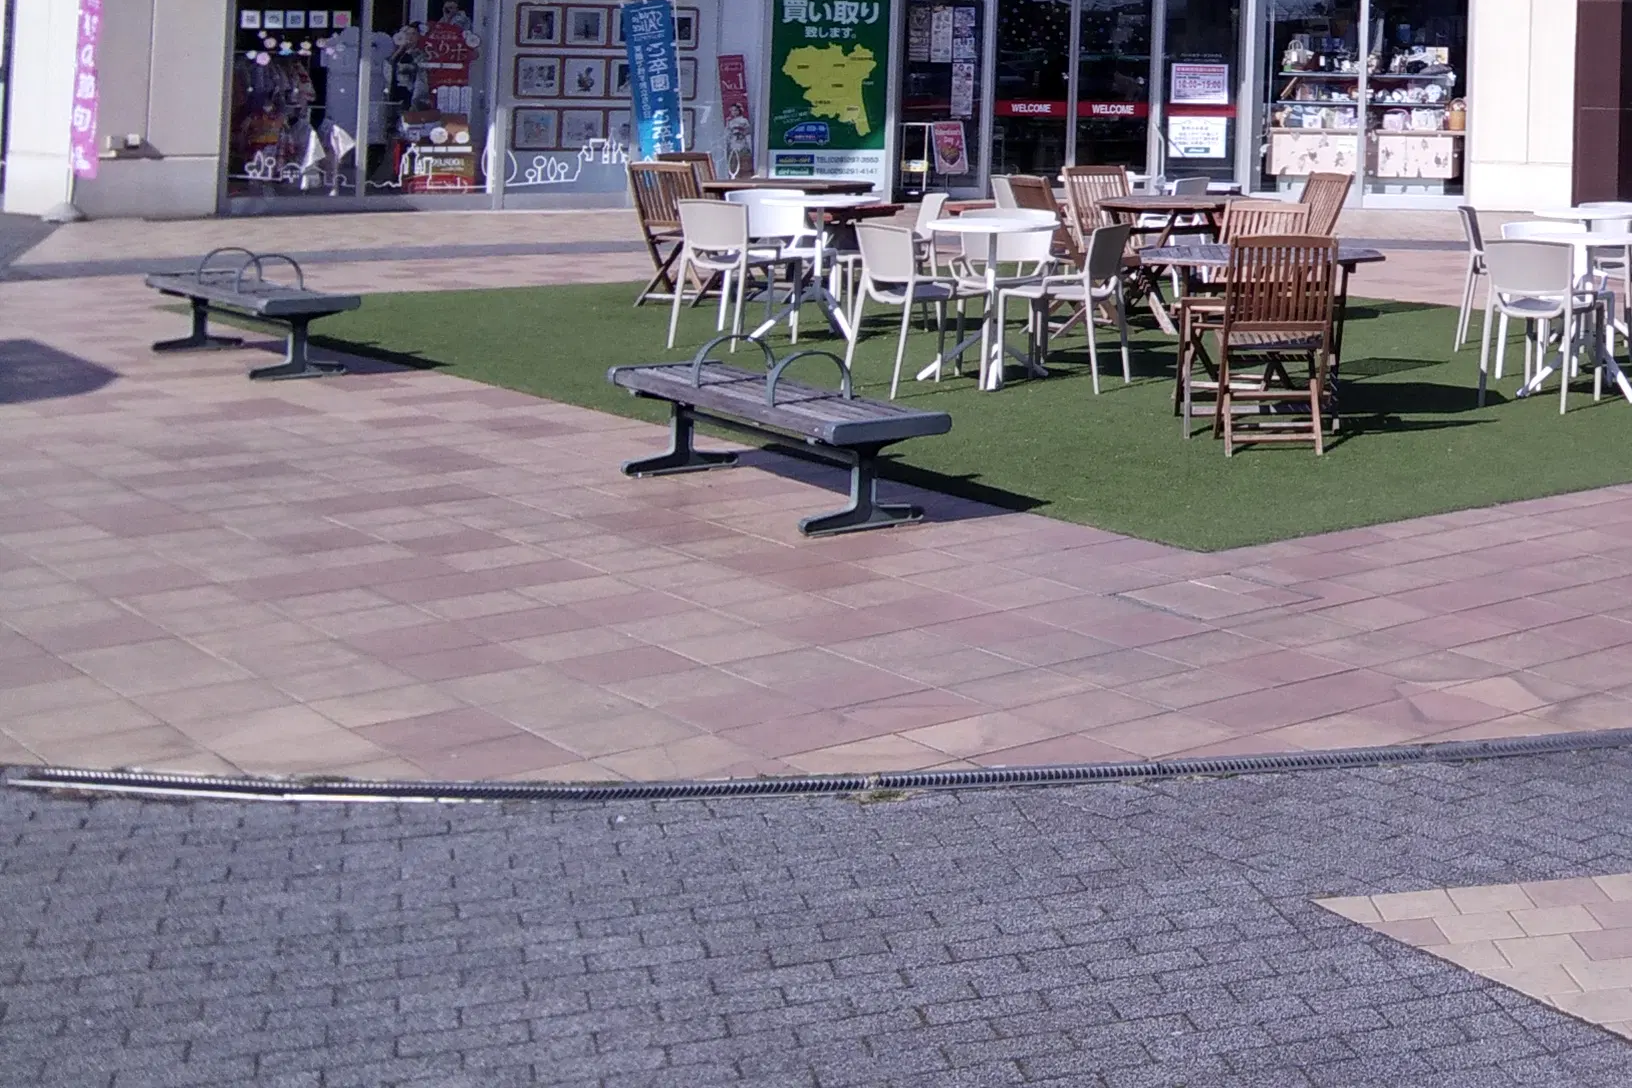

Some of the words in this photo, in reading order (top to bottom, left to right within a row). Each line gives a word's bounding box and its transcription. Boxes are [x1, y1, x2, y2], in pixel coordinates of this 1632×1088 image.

[804, 25, 857, 39] 致します。
[1011, 103, 1052, 113] WELCOME
[1091, 103, 1135, 115] WELCOME
